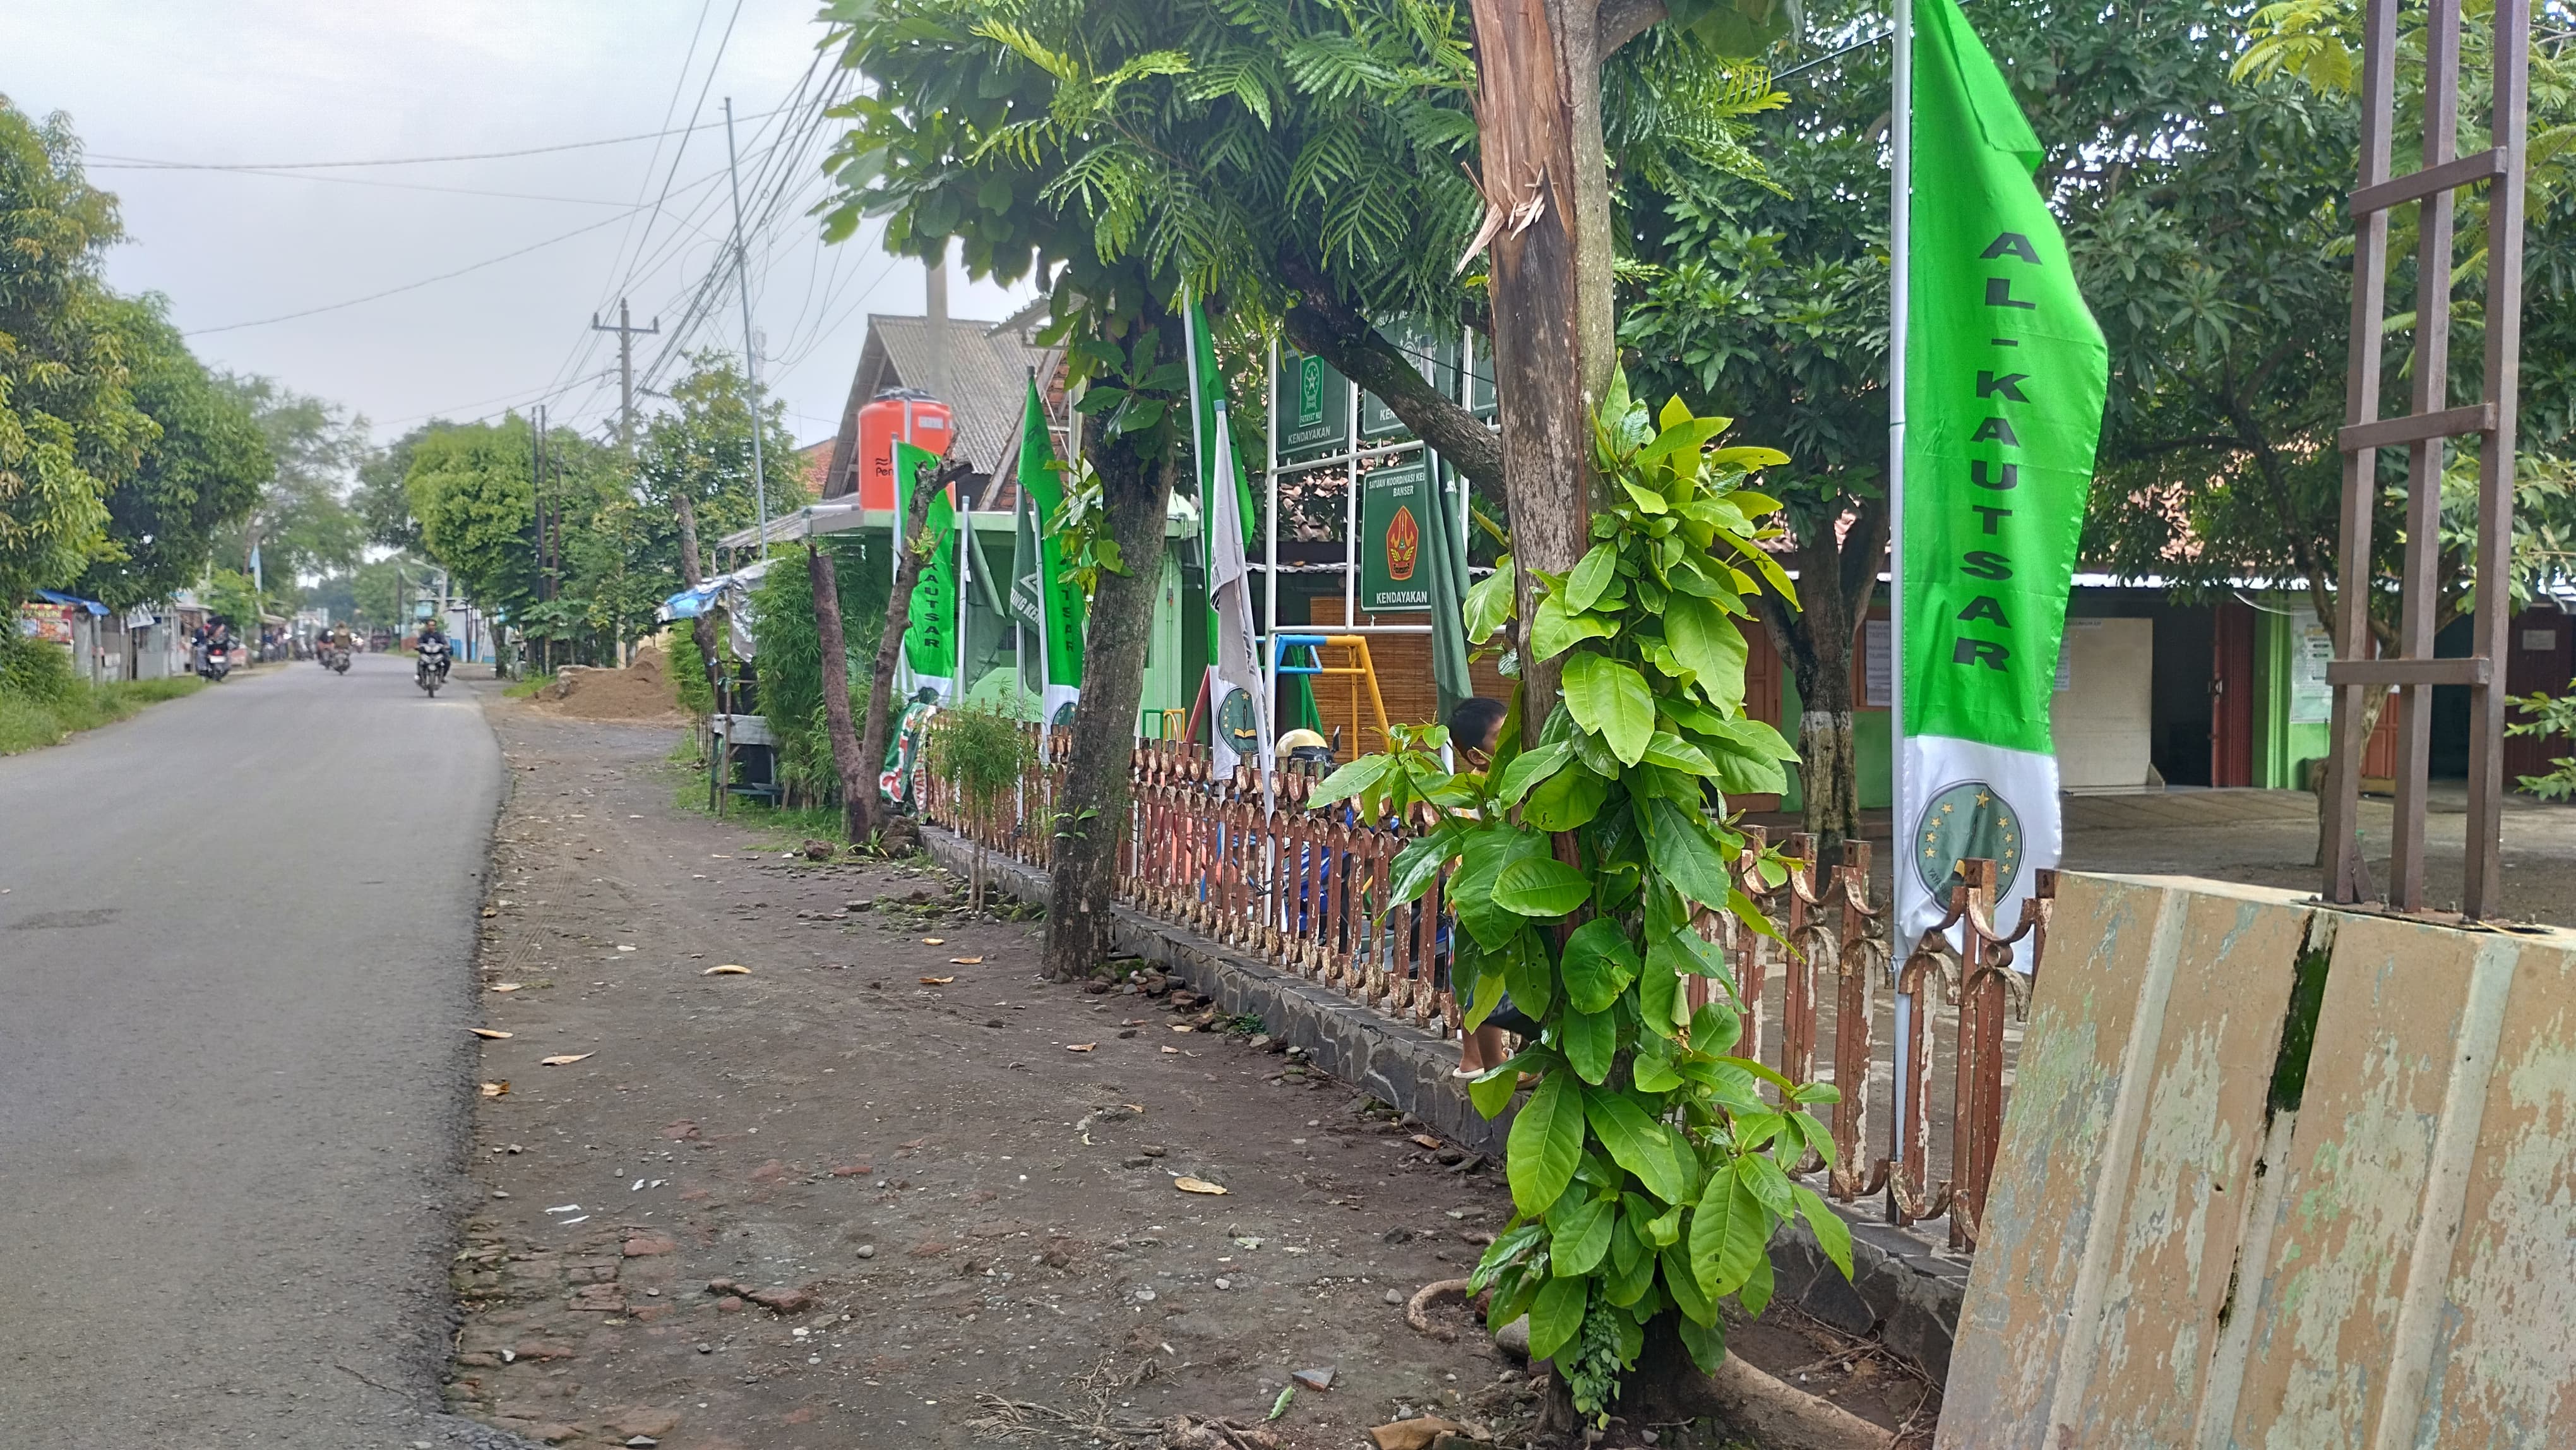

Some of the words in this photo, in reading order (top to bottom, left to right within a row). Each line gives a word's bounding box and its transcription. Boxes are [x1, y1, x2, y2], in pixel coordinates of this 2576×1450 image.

[1288, 426, 1331, 445] KENDAYAKAN
[1952, 231, 2042, 673] AL-KAUTSAR
[1369, 477, 1386, 489] SATUAN
[1386, 474, 1416, 486] KOORDINASI
[1393, 485, 1414, 497] BANSER
[1376, 590, 1428, 604] KENDAYAKAN
